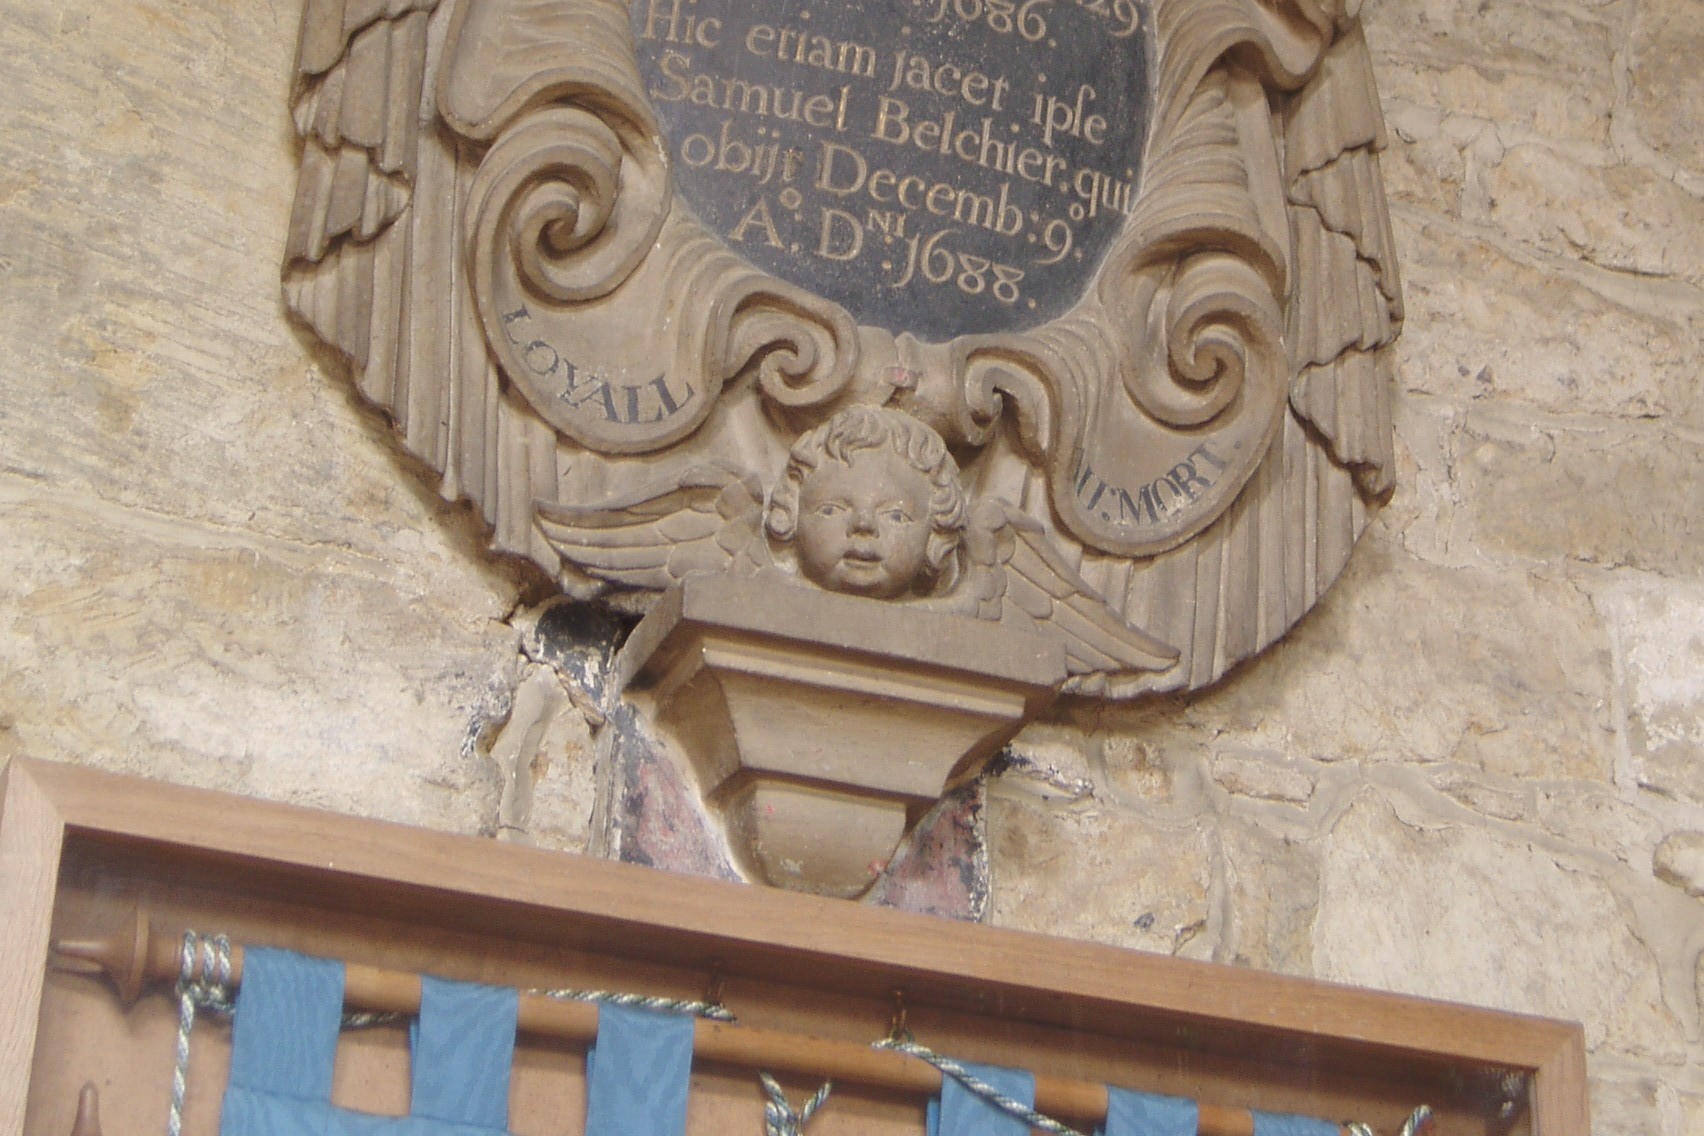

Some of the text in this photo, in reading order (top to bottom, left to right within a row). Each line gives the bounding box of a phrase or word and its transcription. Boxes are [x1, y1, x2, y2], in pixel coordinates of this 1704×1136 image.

[745, 10, 877, 79] etiam
[889, 23, 1010, 112] jacet
[649, 48, 850, 133] Samuel
[1072, 165, 1136, 219] qui
[680, 118, 805, 185] obijt
[814, 139, 1041, 244] Decemb:
